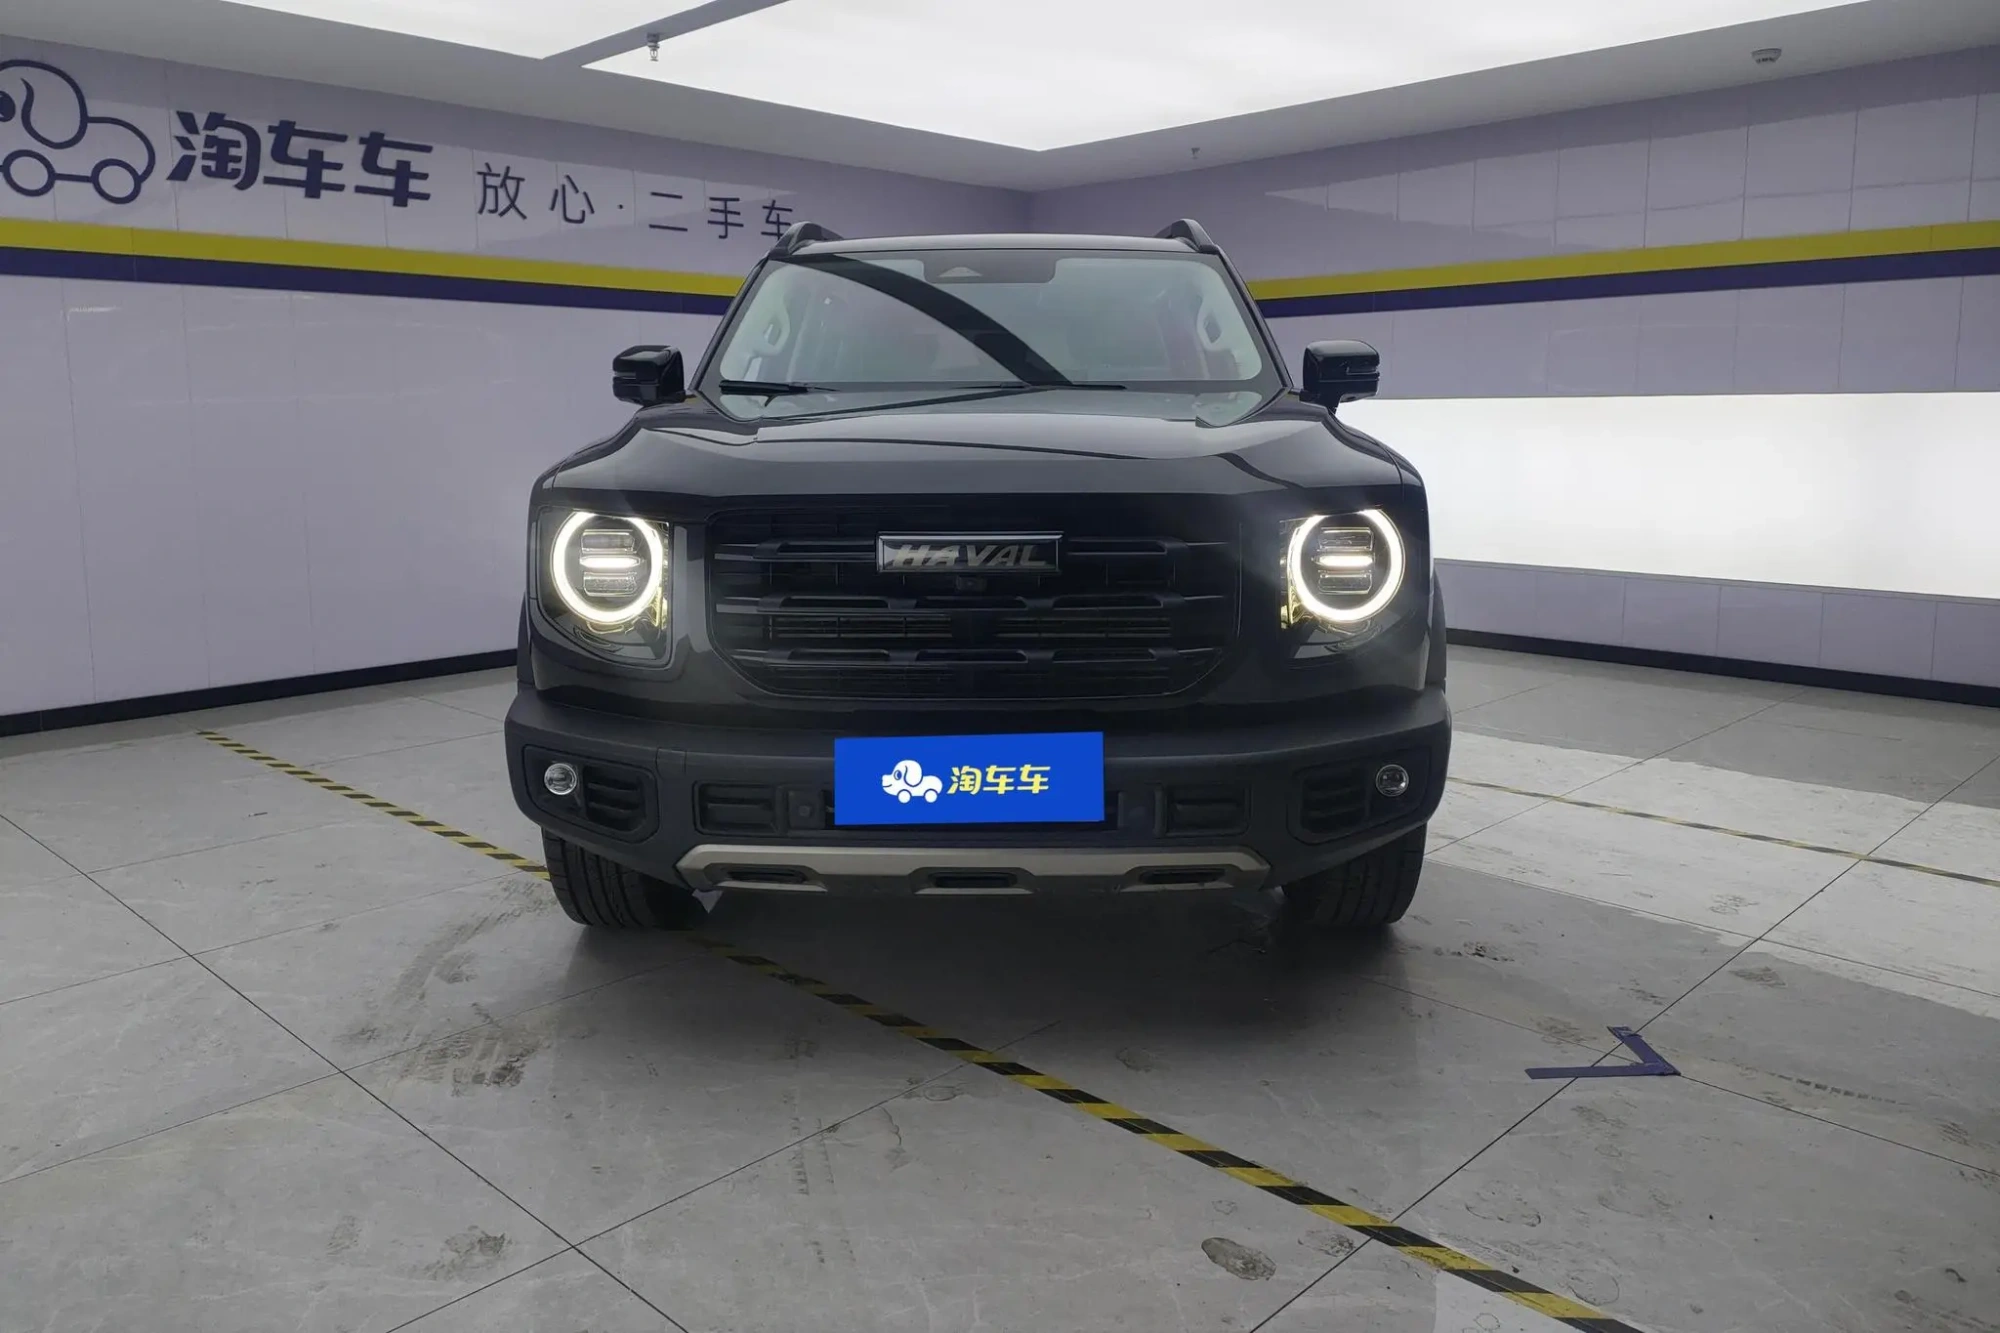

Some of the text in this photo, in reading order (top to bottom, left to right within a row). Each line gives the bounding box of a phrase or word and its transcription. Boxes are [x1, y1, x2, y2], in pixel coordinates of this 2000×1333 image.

[166, 110, 433, 208] 淘车车
[892, 544, 1047, 567] HAVAL
